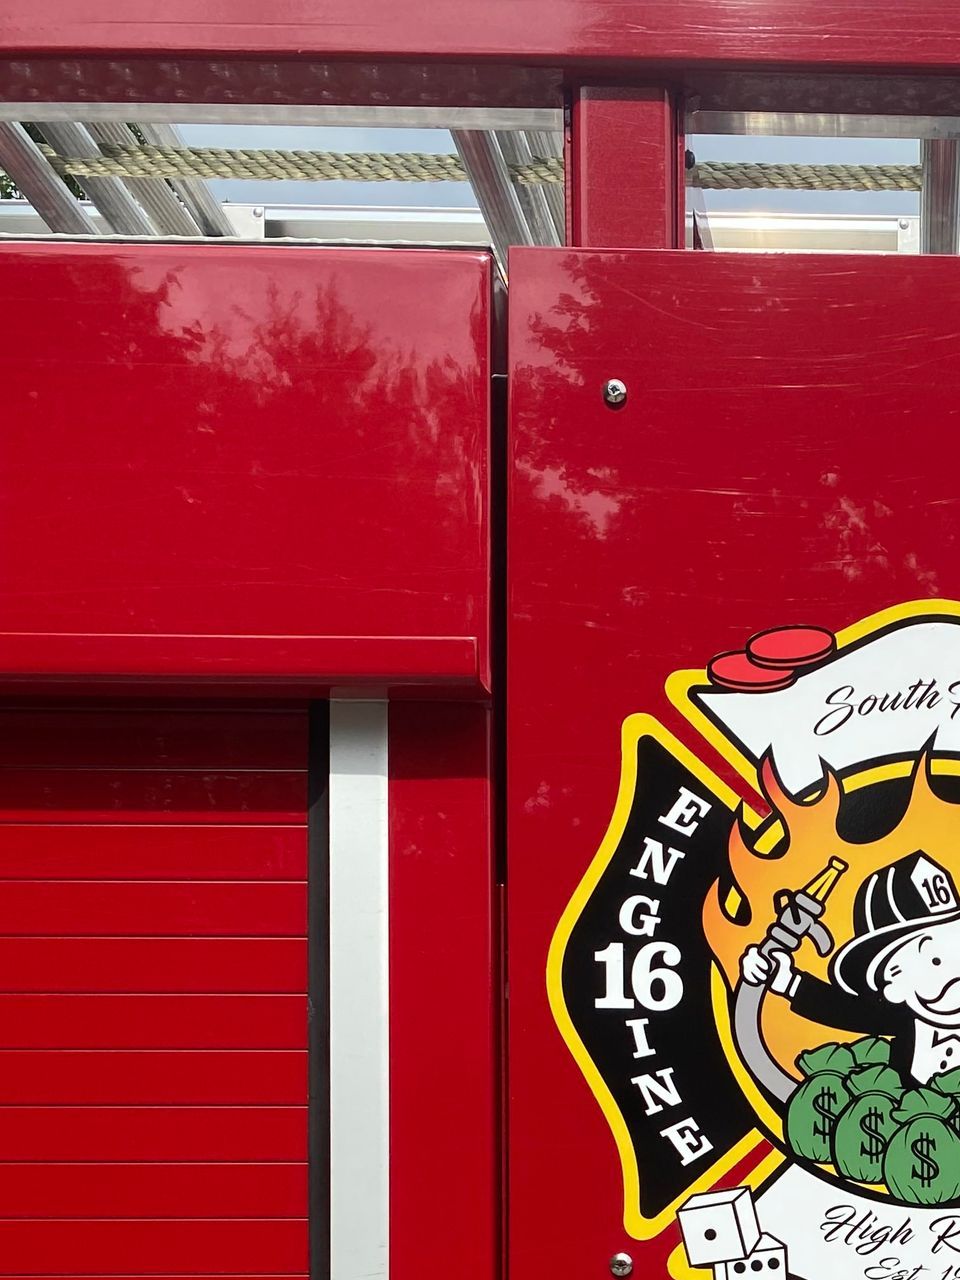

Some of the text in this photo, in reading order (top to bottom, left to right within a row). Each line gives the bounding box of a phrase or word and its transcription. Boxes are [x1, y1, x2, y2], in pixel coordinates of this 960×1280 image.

[813, 678, 943, 736] South
[921, 874, 951, 908] 16
[595, 941, 684, 1011] 16
[820, 1204, 915, 1255] High
